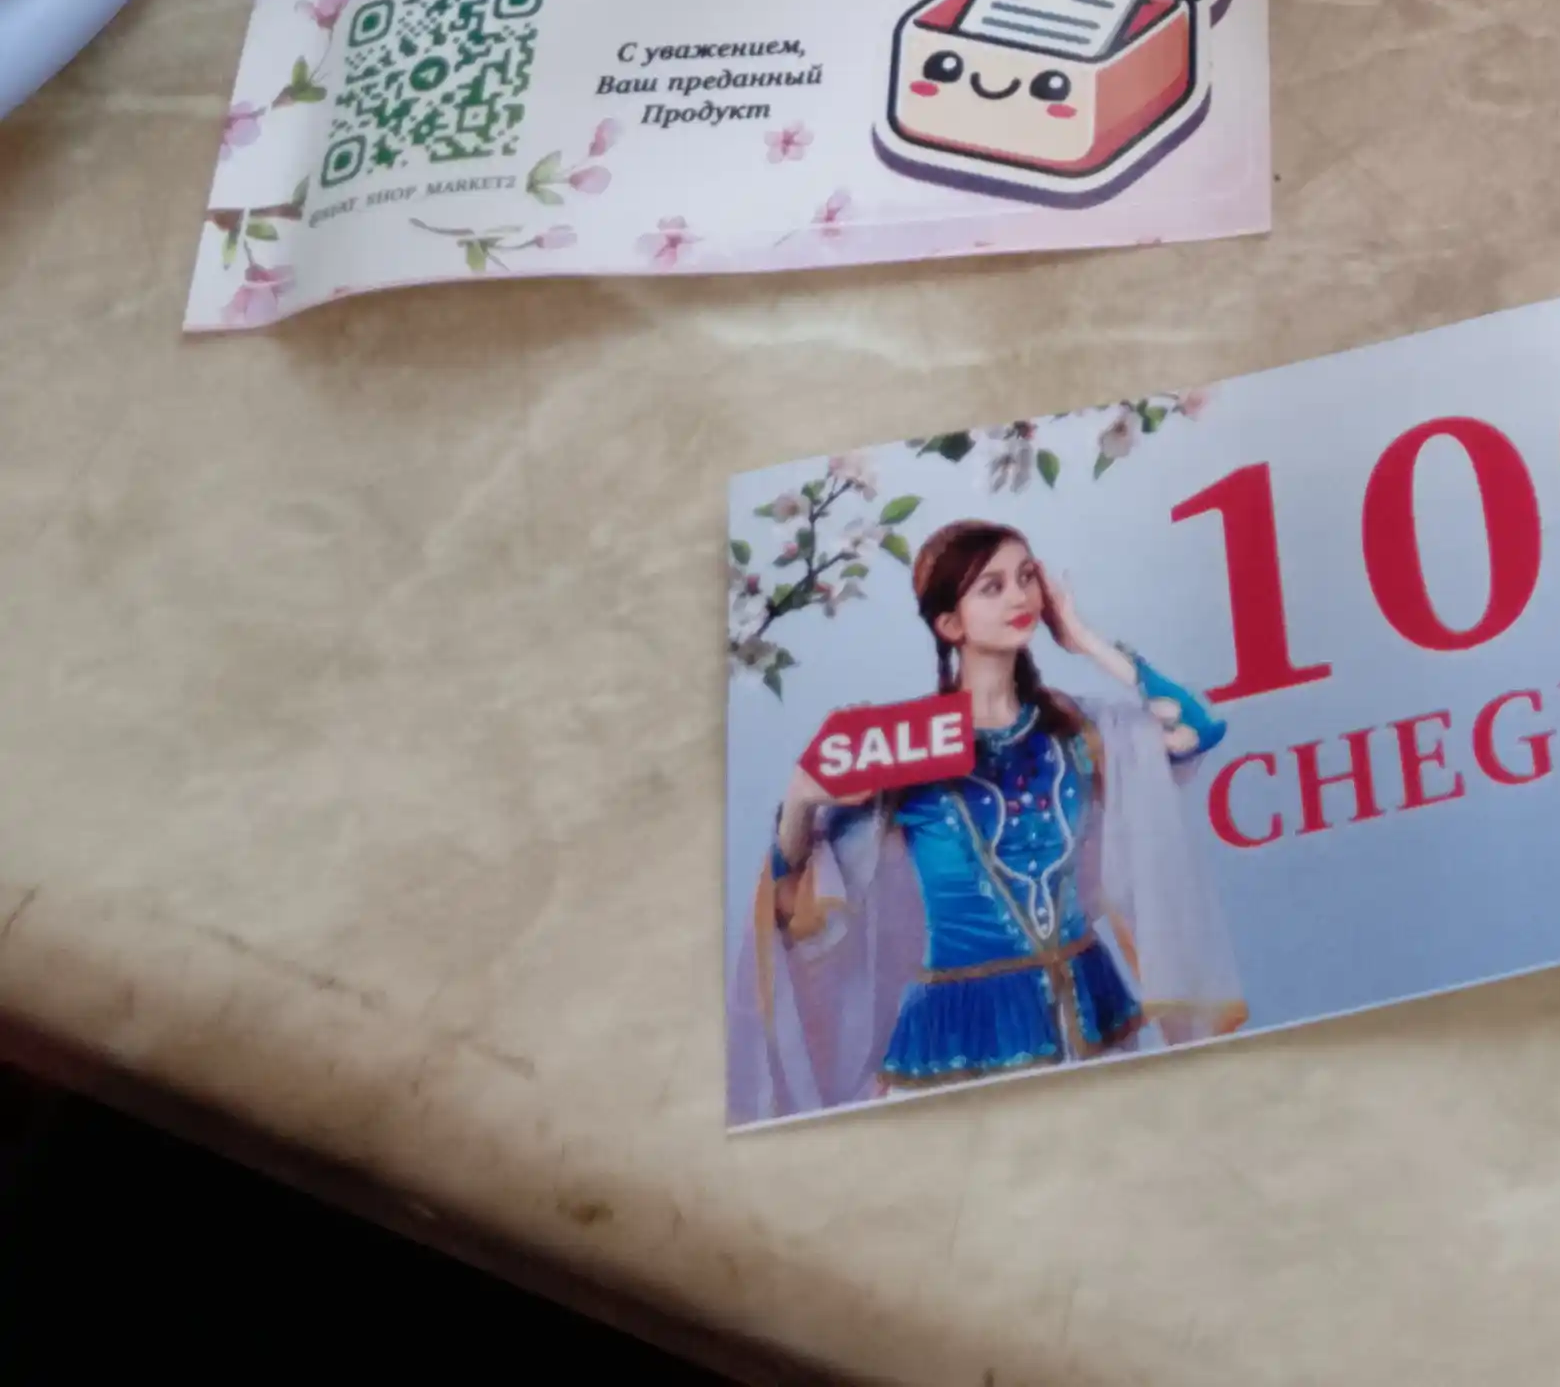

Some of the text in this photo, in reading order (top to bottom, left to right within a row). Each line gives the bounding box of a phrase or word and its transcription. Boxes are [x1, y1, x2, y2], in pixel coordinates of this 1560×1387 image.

[617, 38, 806, 67] С уважением,
[595, 63, 823, 96] Ваш преданный
[641, 100, 771, 129] Продукт
[819, 712, 965, 777] SALE
